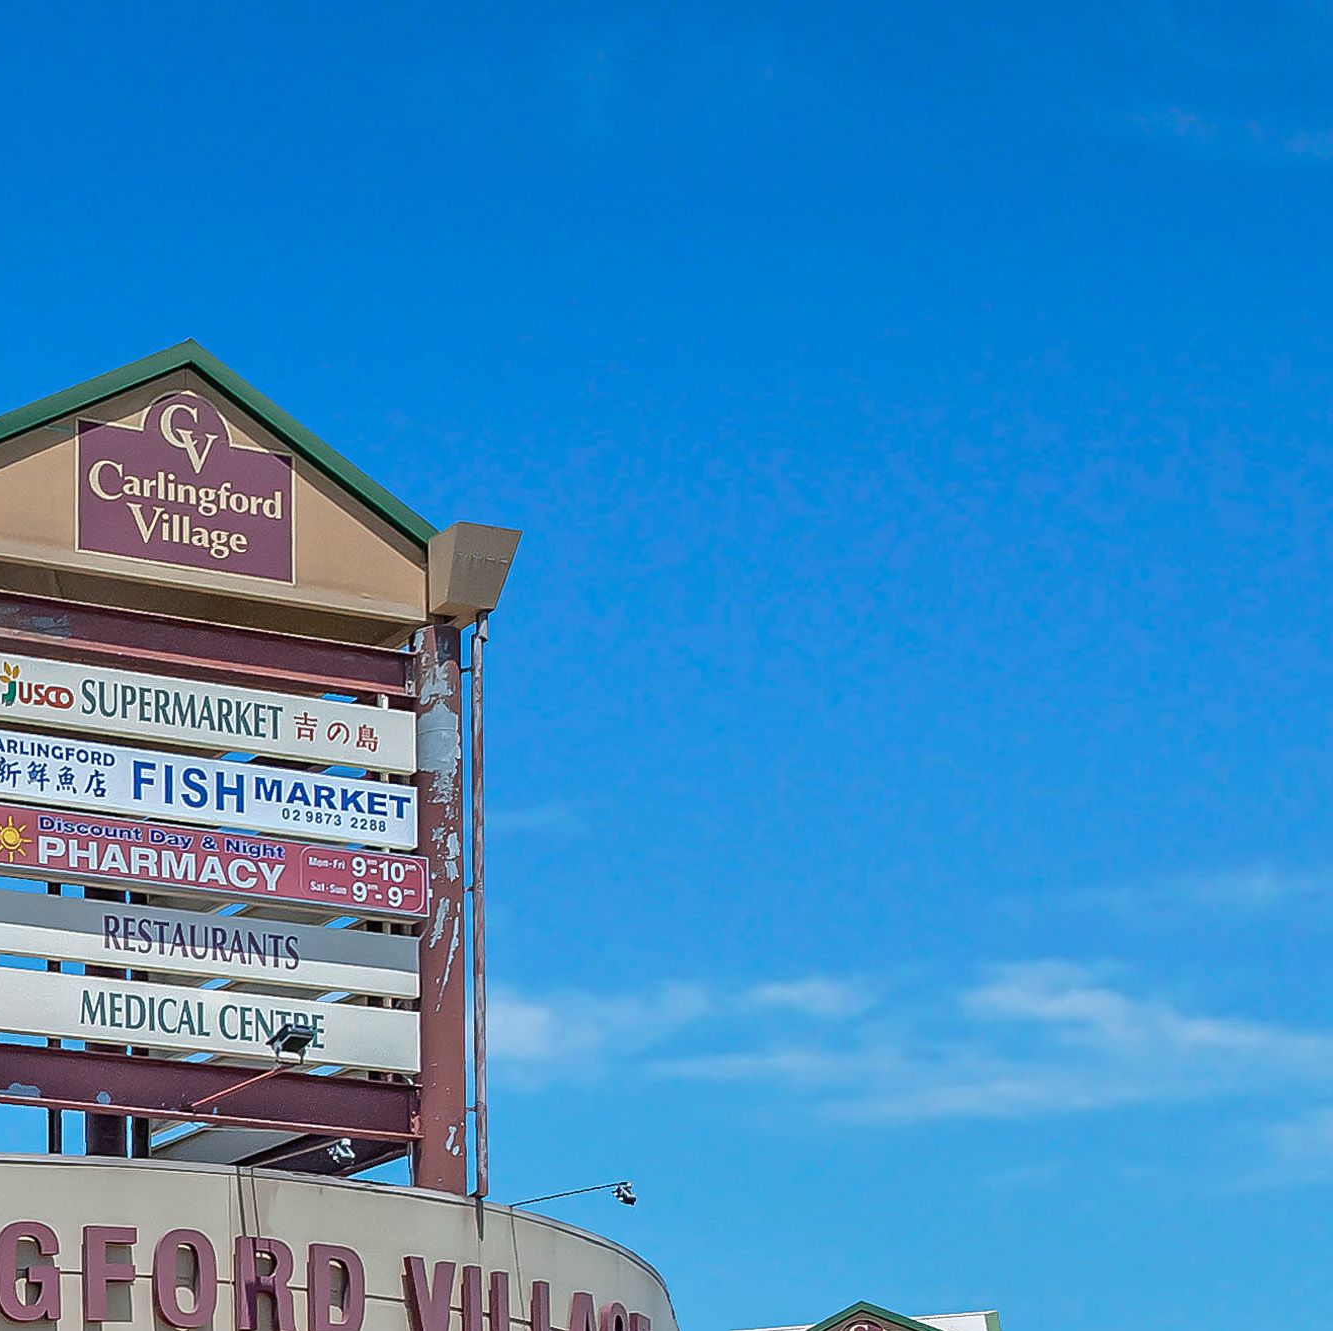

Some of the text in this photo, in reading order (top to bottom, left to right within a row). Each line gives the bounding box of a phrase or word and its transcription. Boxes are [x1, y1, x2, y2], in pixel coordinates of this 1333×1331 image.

[89, 460, 283, 520] Carlingford
[126, 501, 249, 559] Village
[80, 679, 284, 741] SUPERMARKET
[294, 711, 380, 753] 吉の島
[133, 760, 412, 819] FISH MARKET
[39, 815, 285, 860] Discount Day & Night
[282, 807, 386, 832] 02 9873 2288
[37, 835, 286, 892] PHARMACY
[103, 914, 300, 970] RESTAURANTS
[80, 989, 211, 1038] MEDICAL
